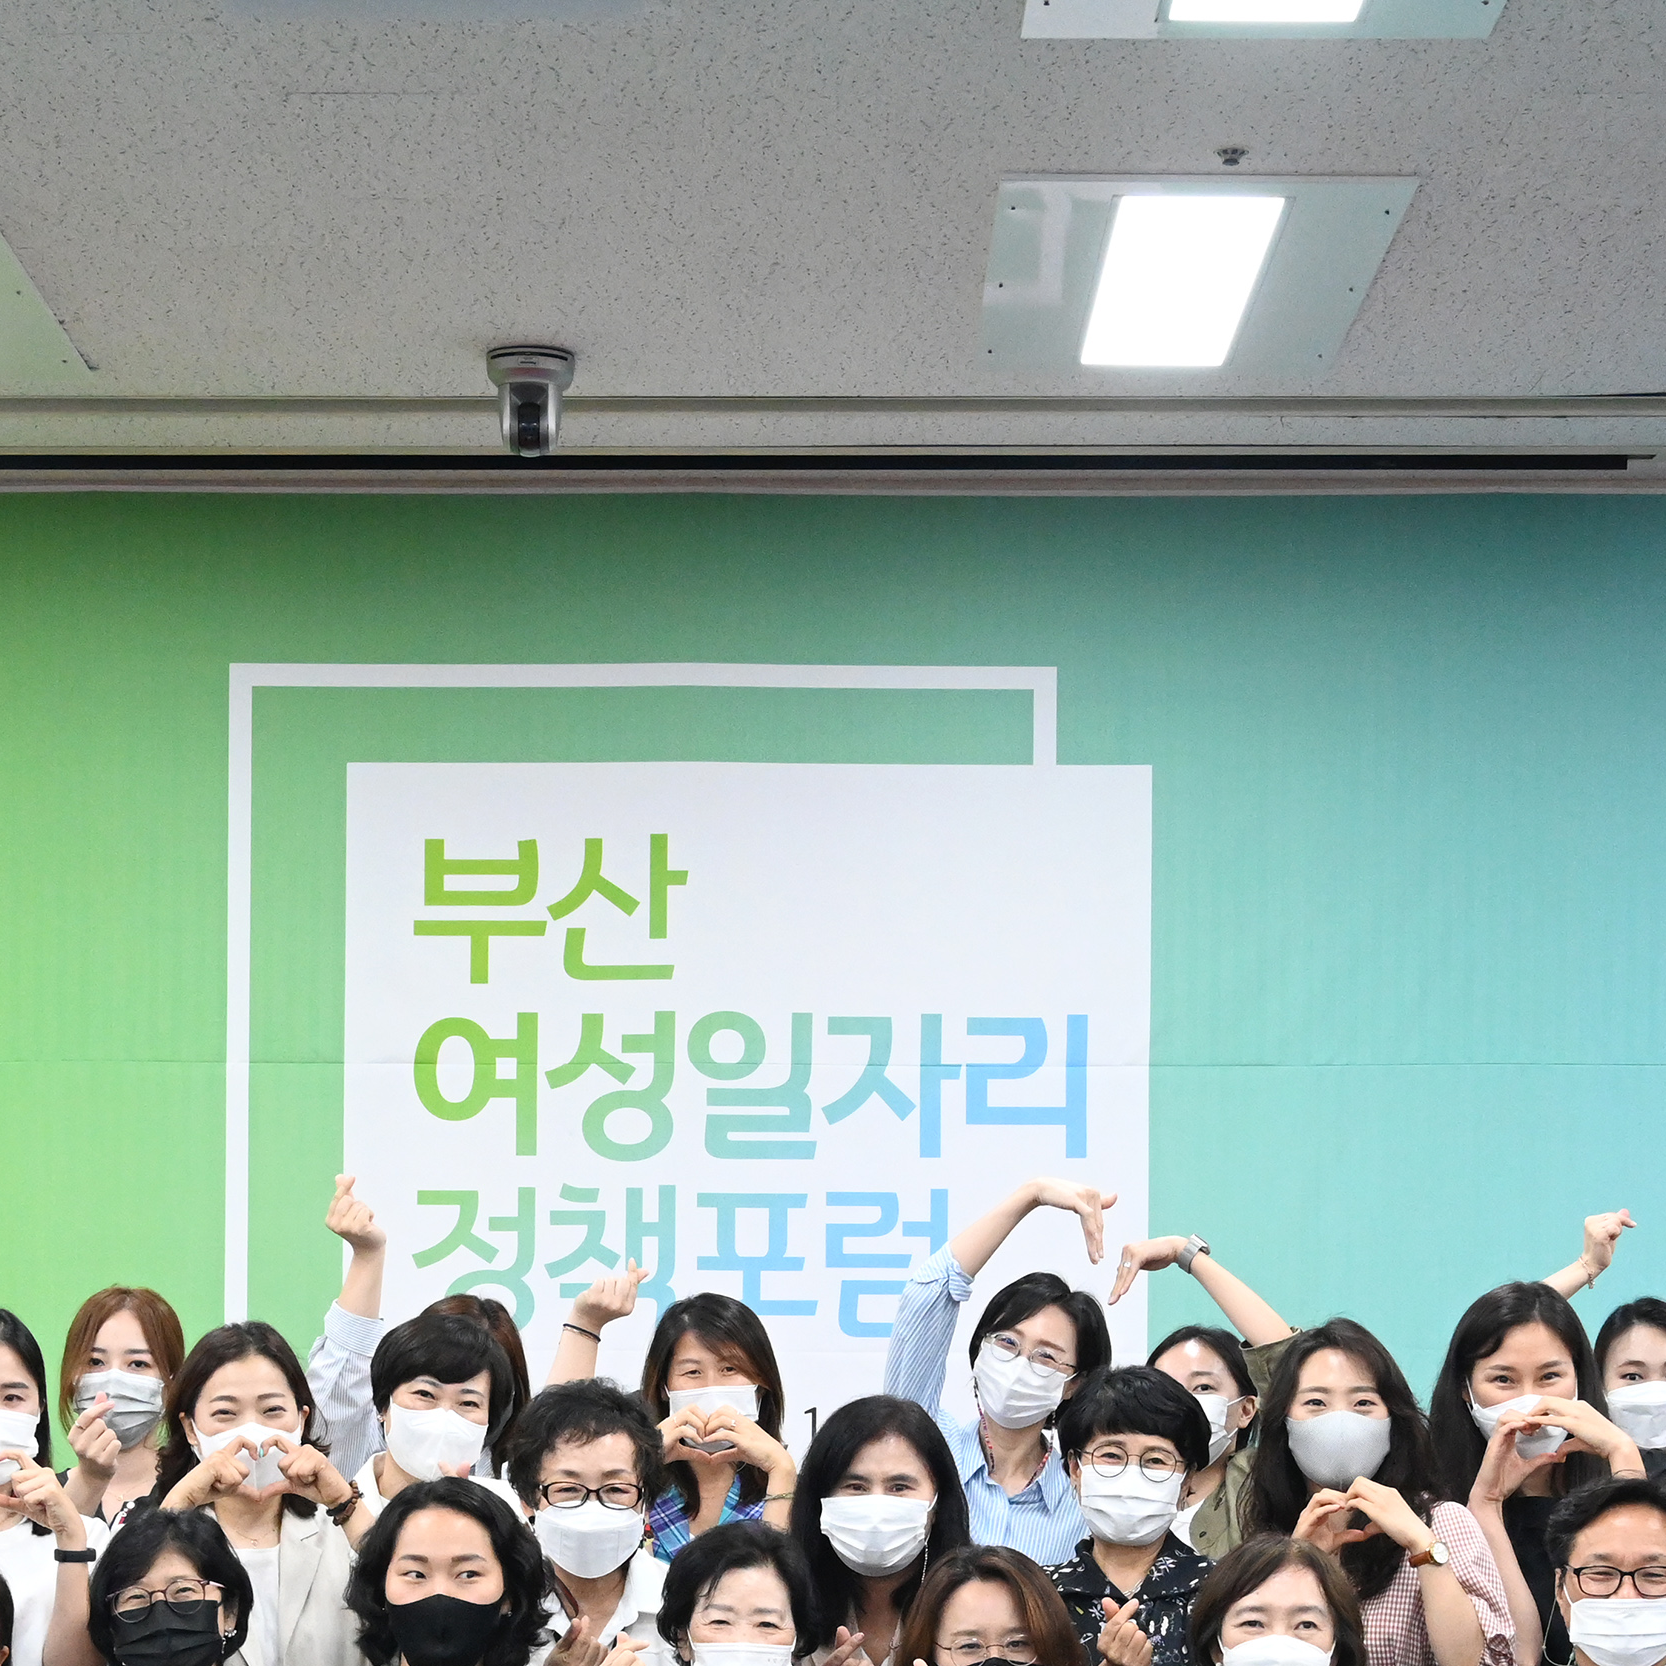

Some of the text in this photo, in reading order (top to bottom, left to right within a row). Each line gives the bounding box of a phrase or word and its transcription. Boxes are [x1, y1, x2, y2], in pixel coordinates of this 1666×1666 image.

[413, 833, 689, 985] 부산
[413, 1009, 1089, 1163] 여성일자리
[410, 1183, 950, 1338] 정책포럼
